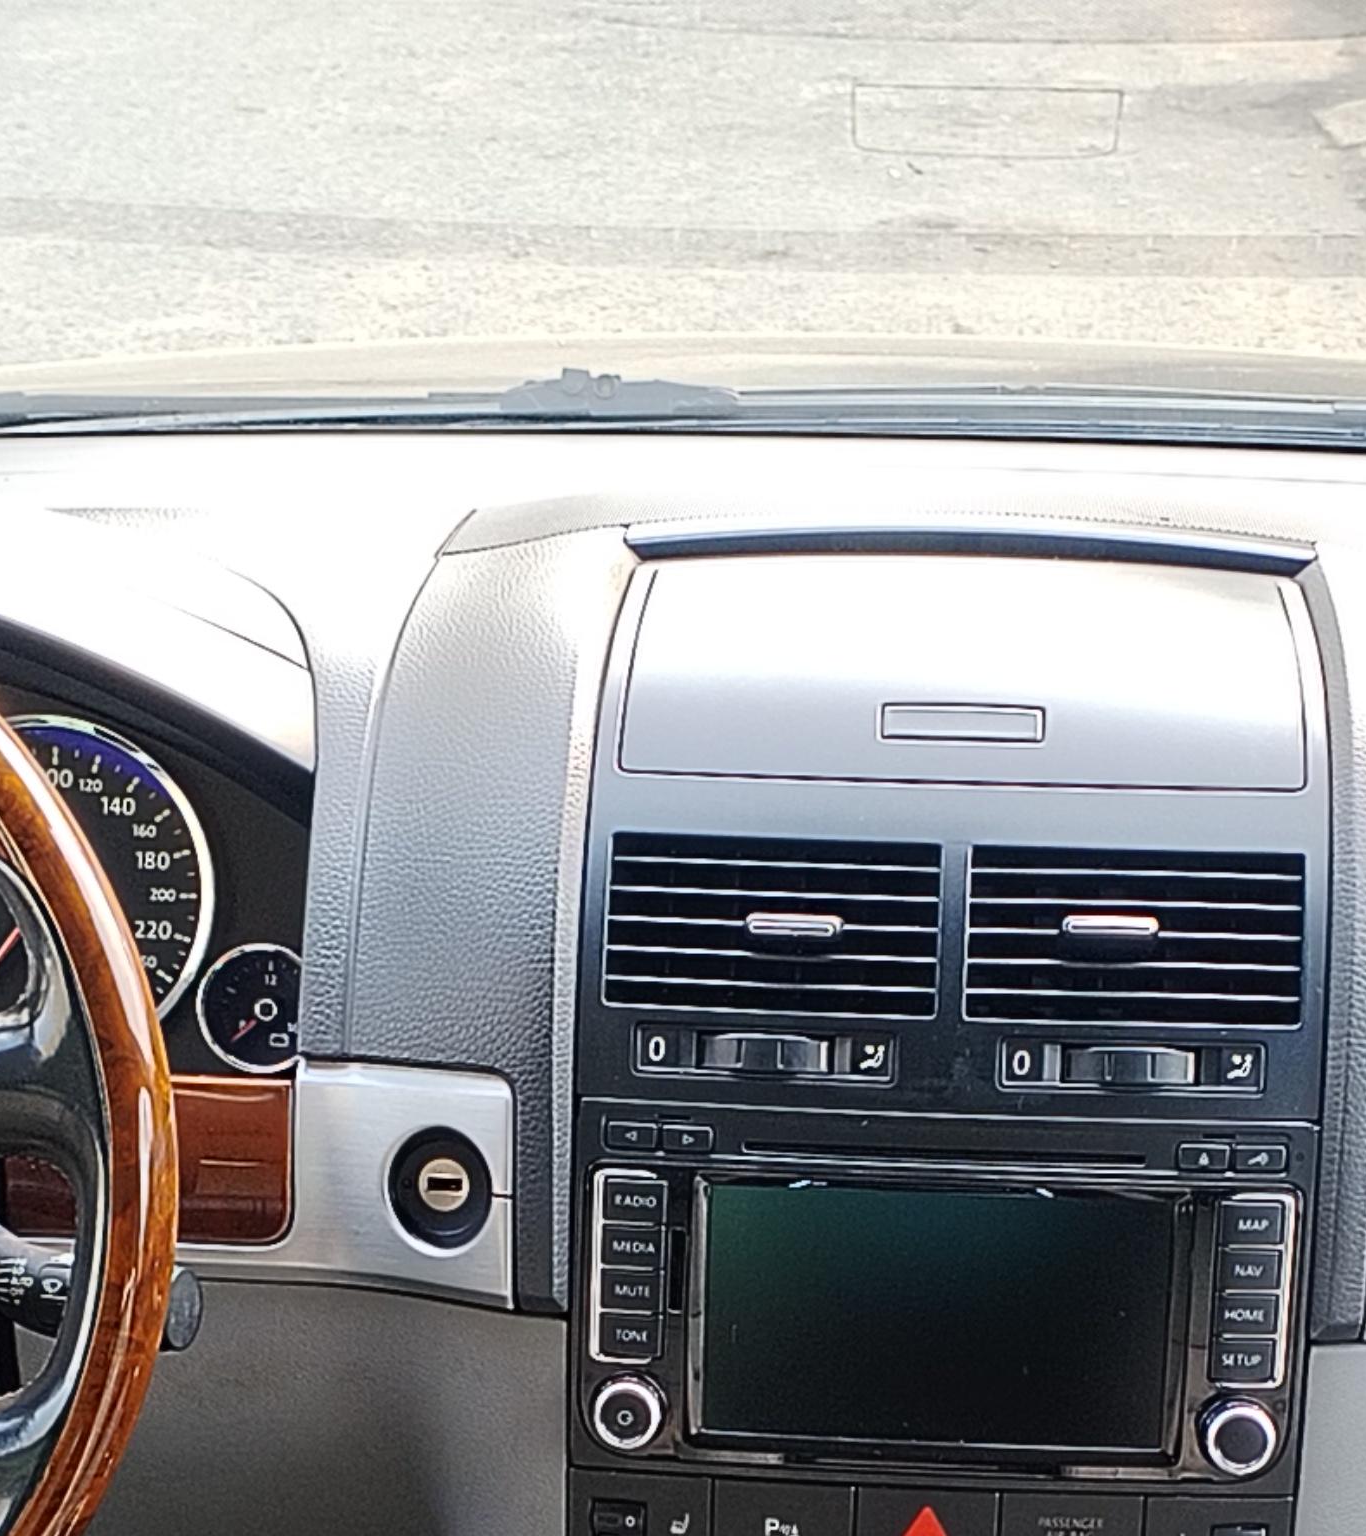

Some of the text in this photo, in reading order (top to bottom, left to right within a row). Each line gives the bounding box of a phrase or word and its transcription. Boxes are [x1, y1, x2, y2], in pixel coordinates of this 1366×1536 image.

[78, 778, 103, 793] 120
[100, 797, 135, 816] 140
[132, 823, 157, 838] 160
[136, 851, 170, 870] 180
[149, 888, 176, 902] 200
[135, 920, 172, 939] 220
[614, 1194, 658, 1209] RADIO
[1238, 1217, 1270, 1232] MAP
[612, 1239, 656, 1255] MEDIA
[1235, 1264, 1264, 1279] NAV
[614, 1284, 651, 1299] MUTE
[1224, 1307, 1265, 1323] HOME
[615, 1328, 649, 1343] TONE
[1221, 1352, 1263, 1368] SETUP
[1037, 1516, 1104, 1529] PASSENGER
